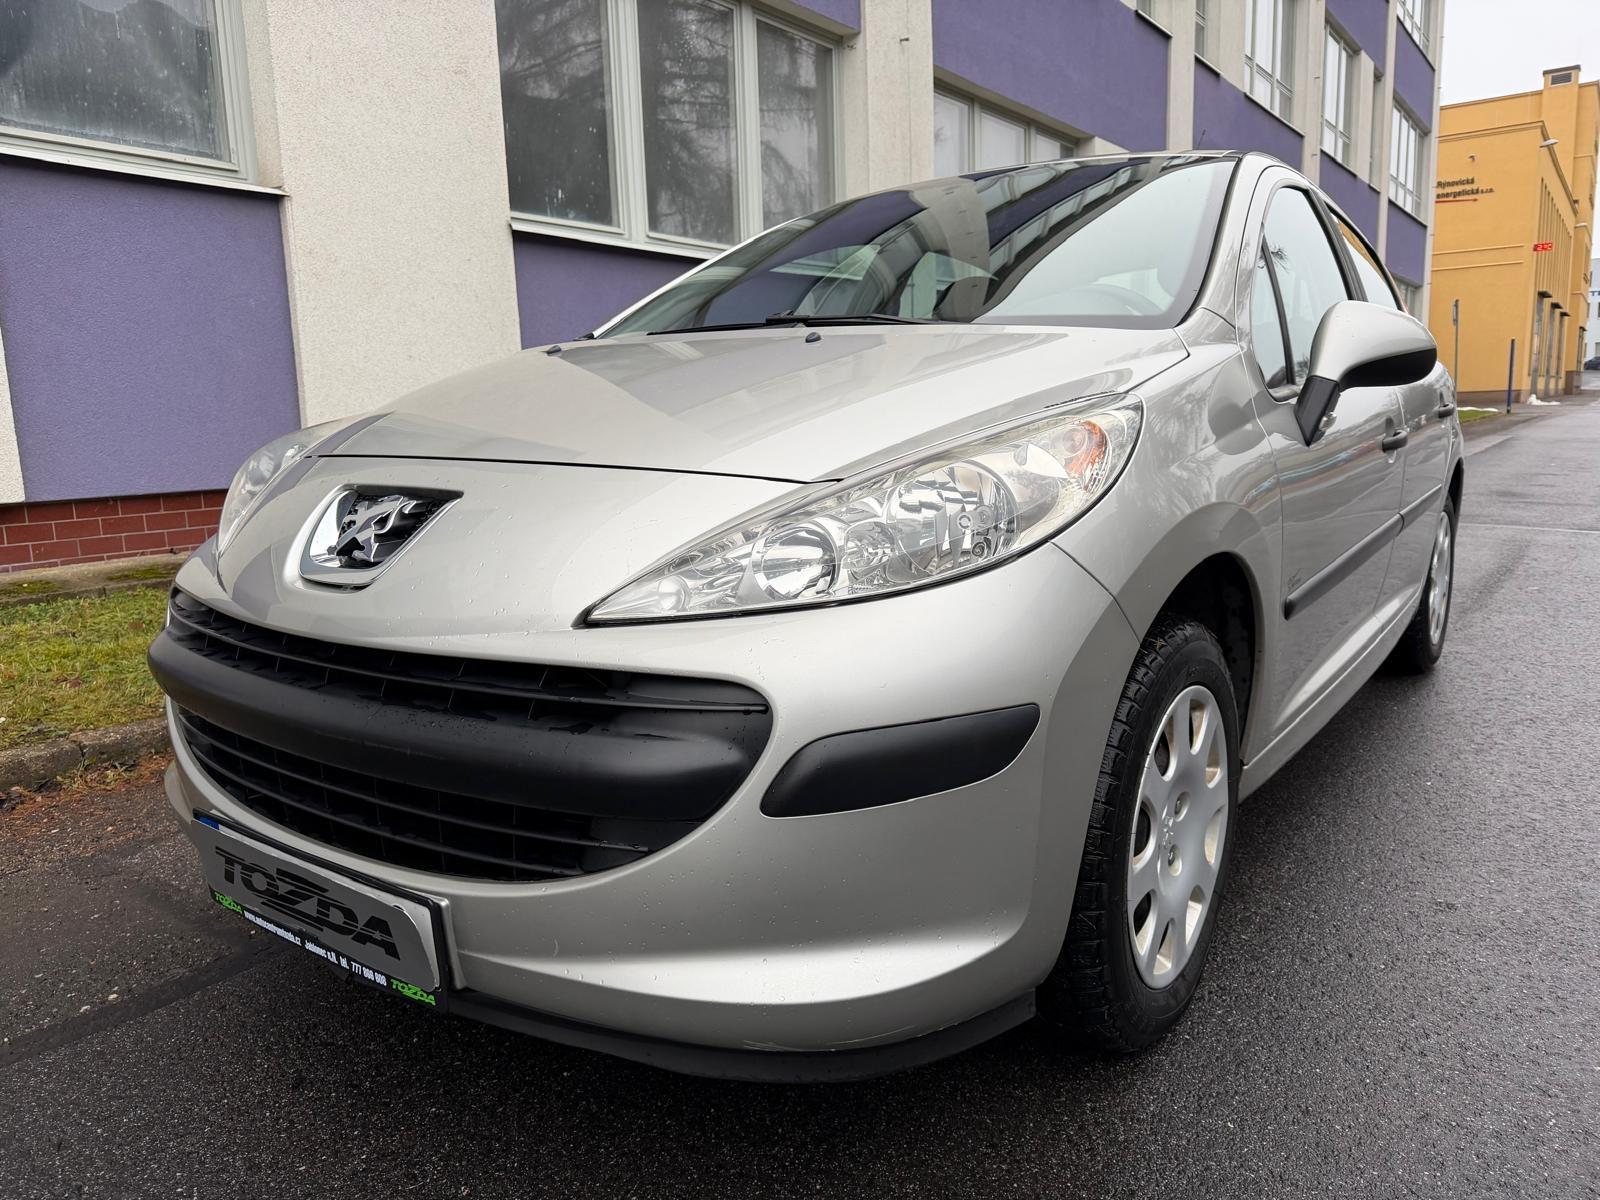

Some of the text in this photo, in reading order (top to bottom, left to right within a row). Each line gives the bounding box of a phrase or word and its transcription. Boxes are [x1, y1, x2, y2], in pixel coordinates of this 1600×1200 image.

[1436, 176, 1475, 189] Rýnovická
[1436, 187, 1480, 200] energetická
[215, 846, 400, 960] TOZDA
[214, 892, 243, 915] TOZDA
[339, 955, 350, 970] tel.
[350, 960, 362, 976] 777
[391, 978, 436, 1006] TOZDA
